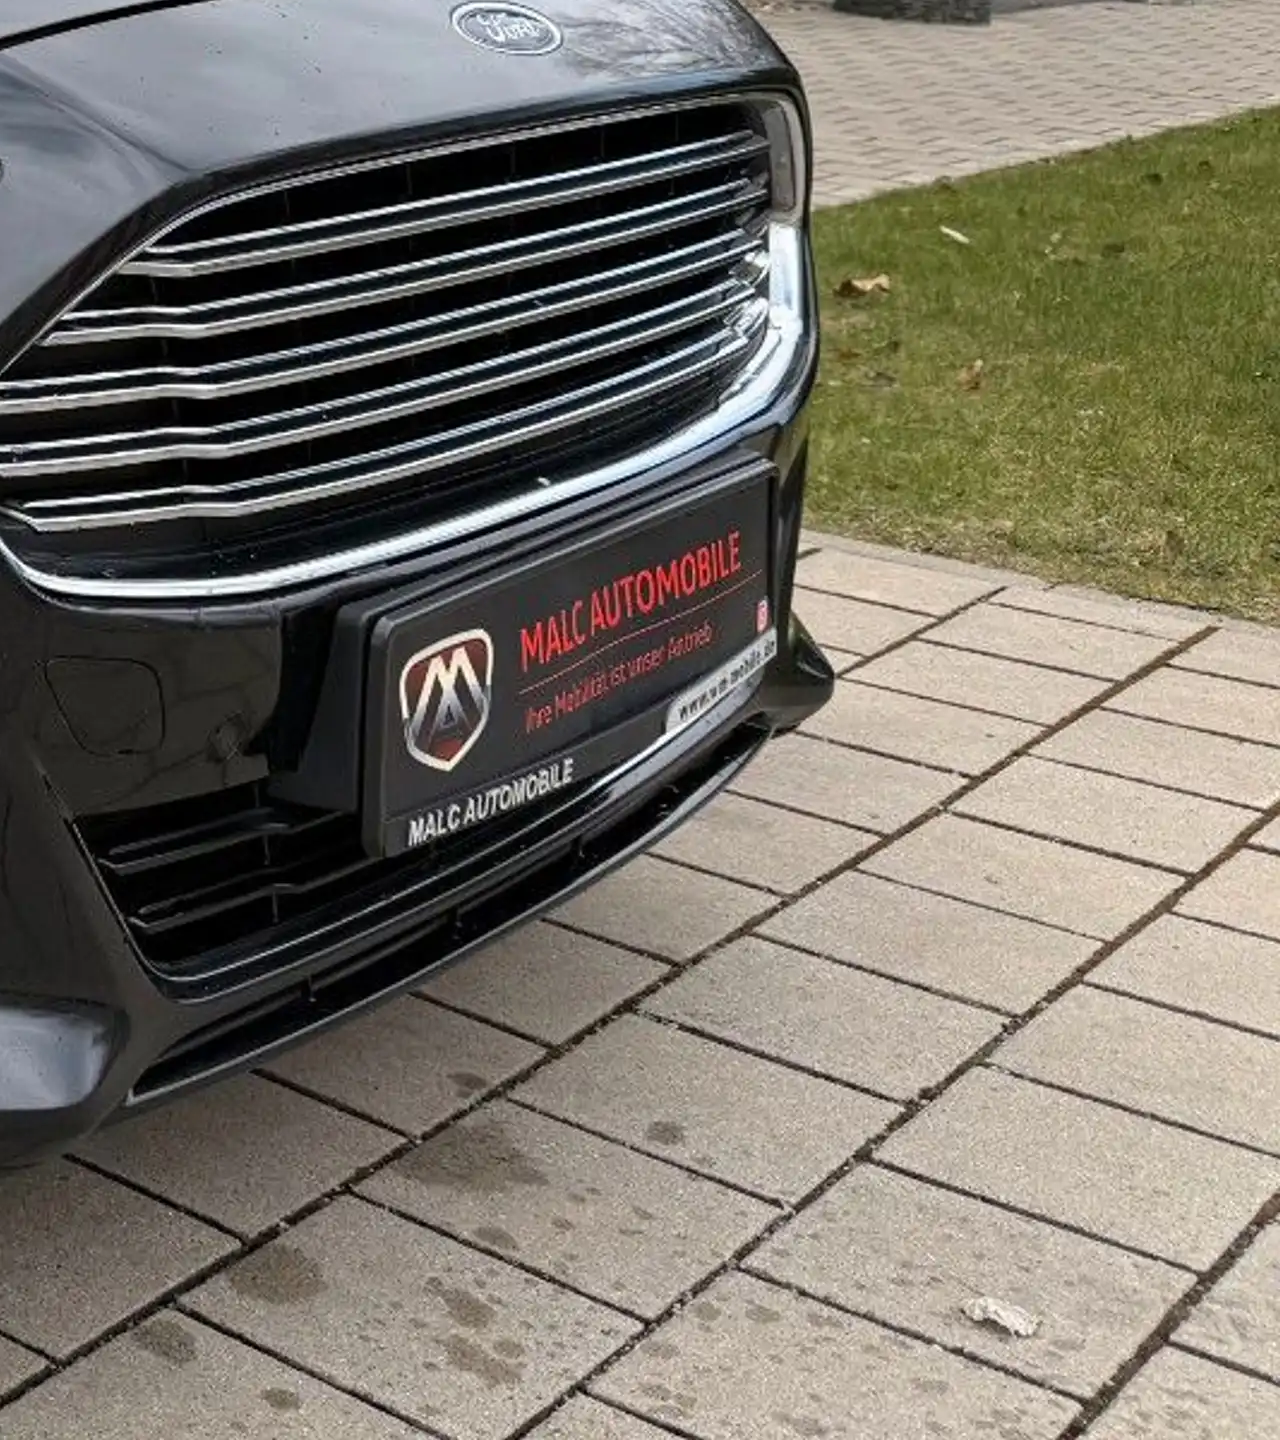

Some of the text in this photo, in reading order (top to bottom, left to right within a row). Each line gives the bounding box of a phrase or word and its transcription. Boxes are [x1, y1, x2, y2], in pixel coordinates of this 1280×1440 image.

[519, 529, 742, 672] MALC AUTOMOBILE
[407, 757, 575, 847] MALC AUTOMOBILE
